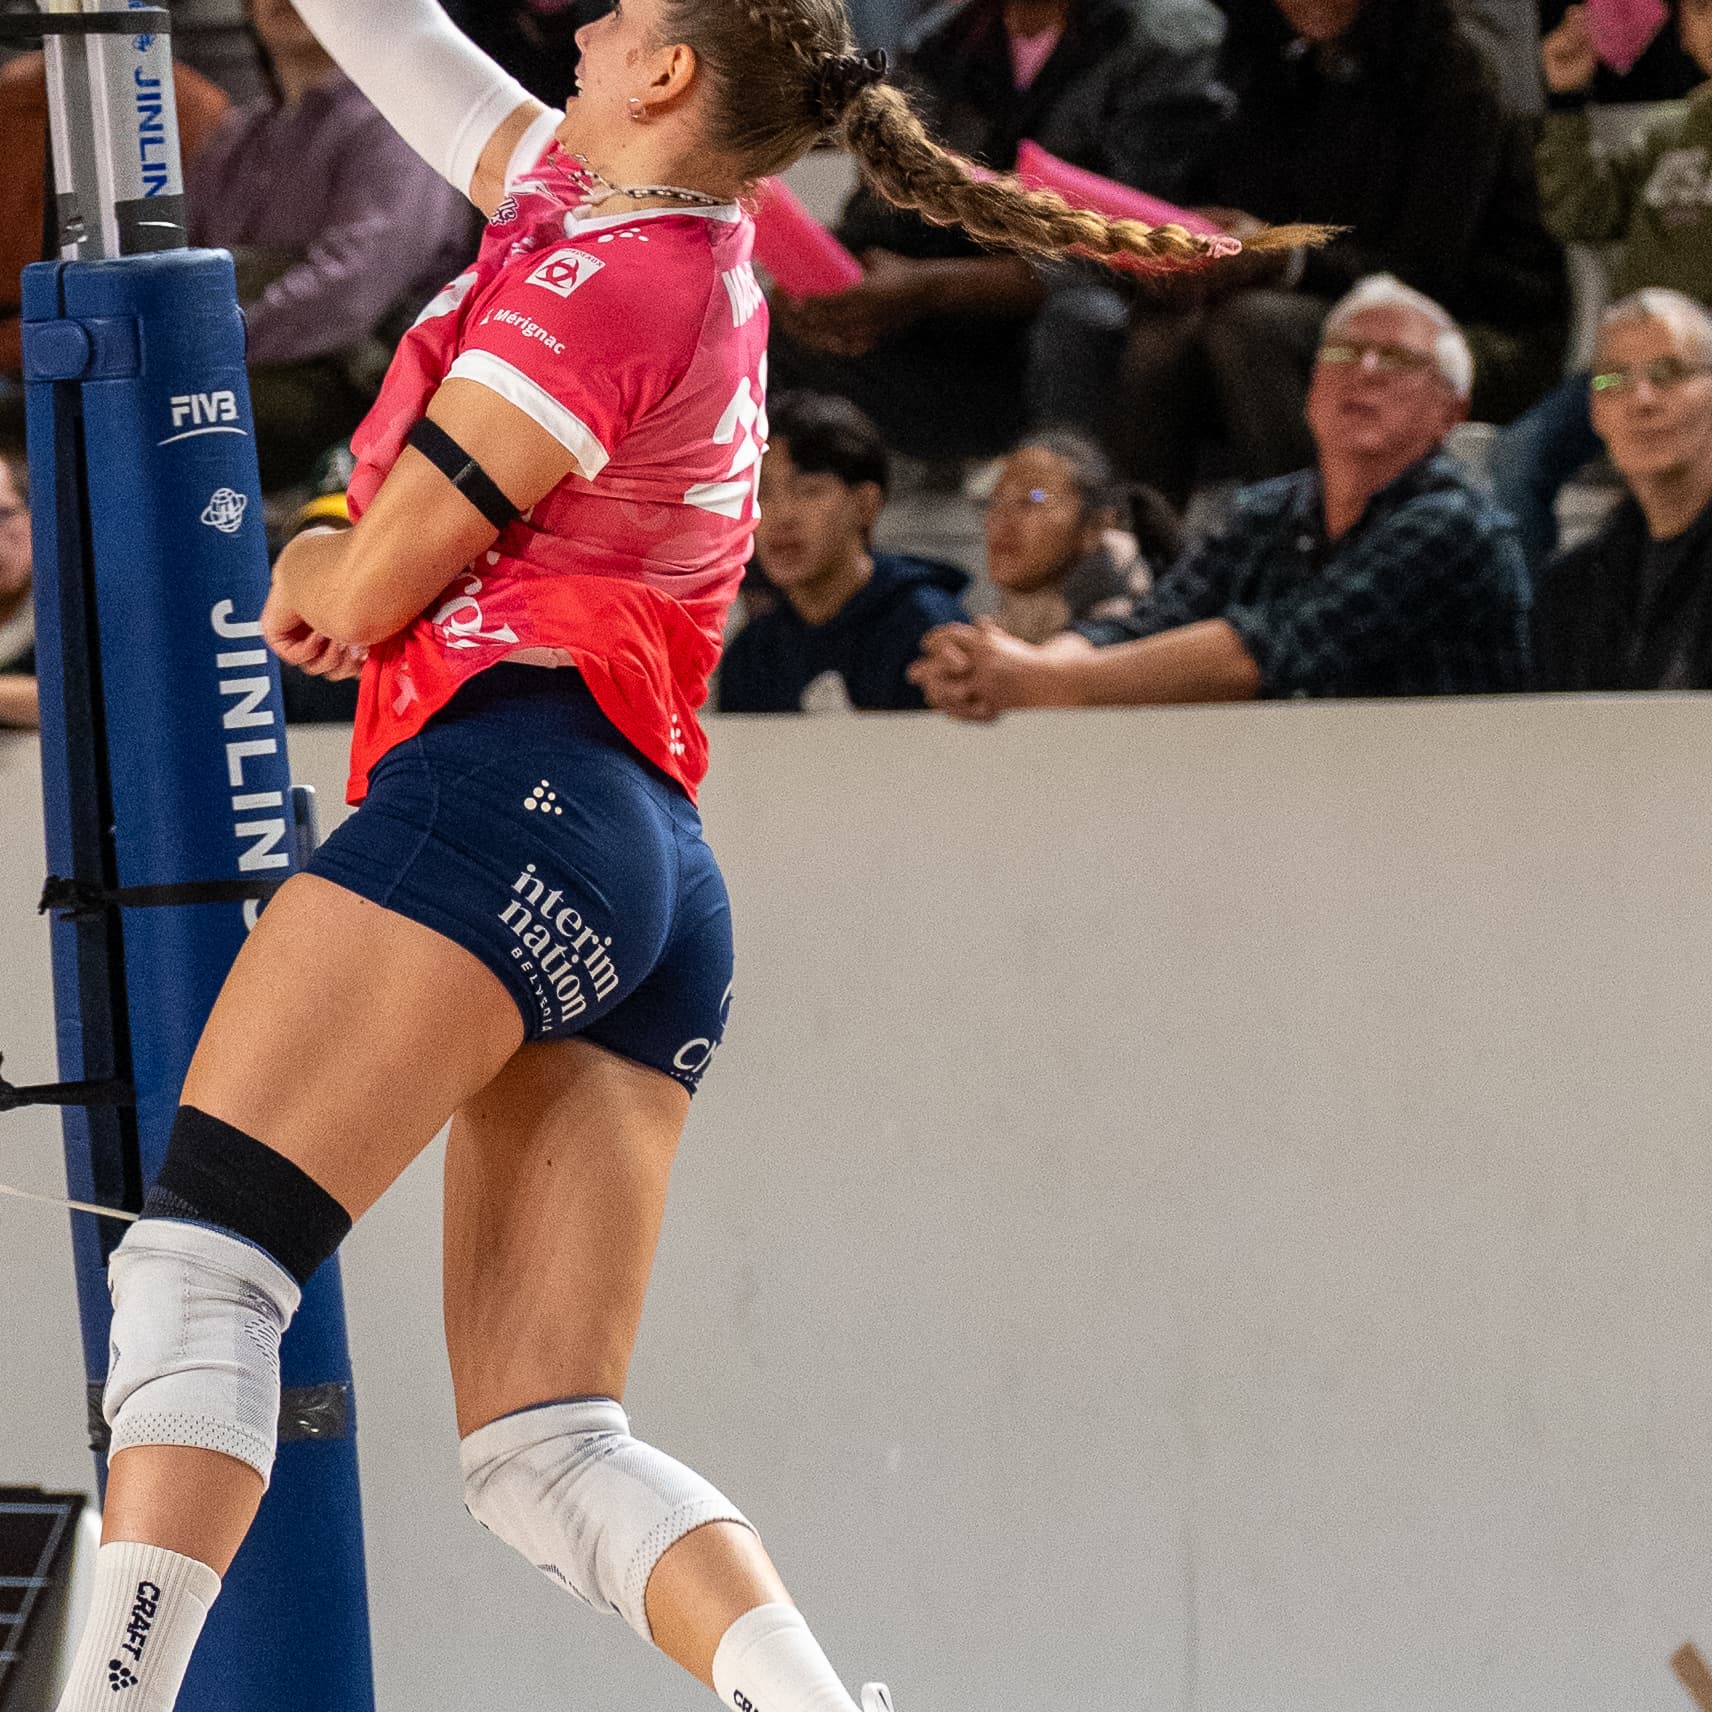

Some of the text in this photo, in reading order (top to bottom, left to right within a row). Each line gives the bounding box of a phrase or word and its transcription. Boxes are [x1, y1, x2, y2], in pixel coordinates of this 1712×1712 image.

[493, 308, 566, 355] Mérignac
[170, 390, 239, 427] FIVB
[497, 899, 587, 1023] nation
[510, 946, 553, 1032] BELVEDIA
[122, 1580, 161, 1662] CRAFT
